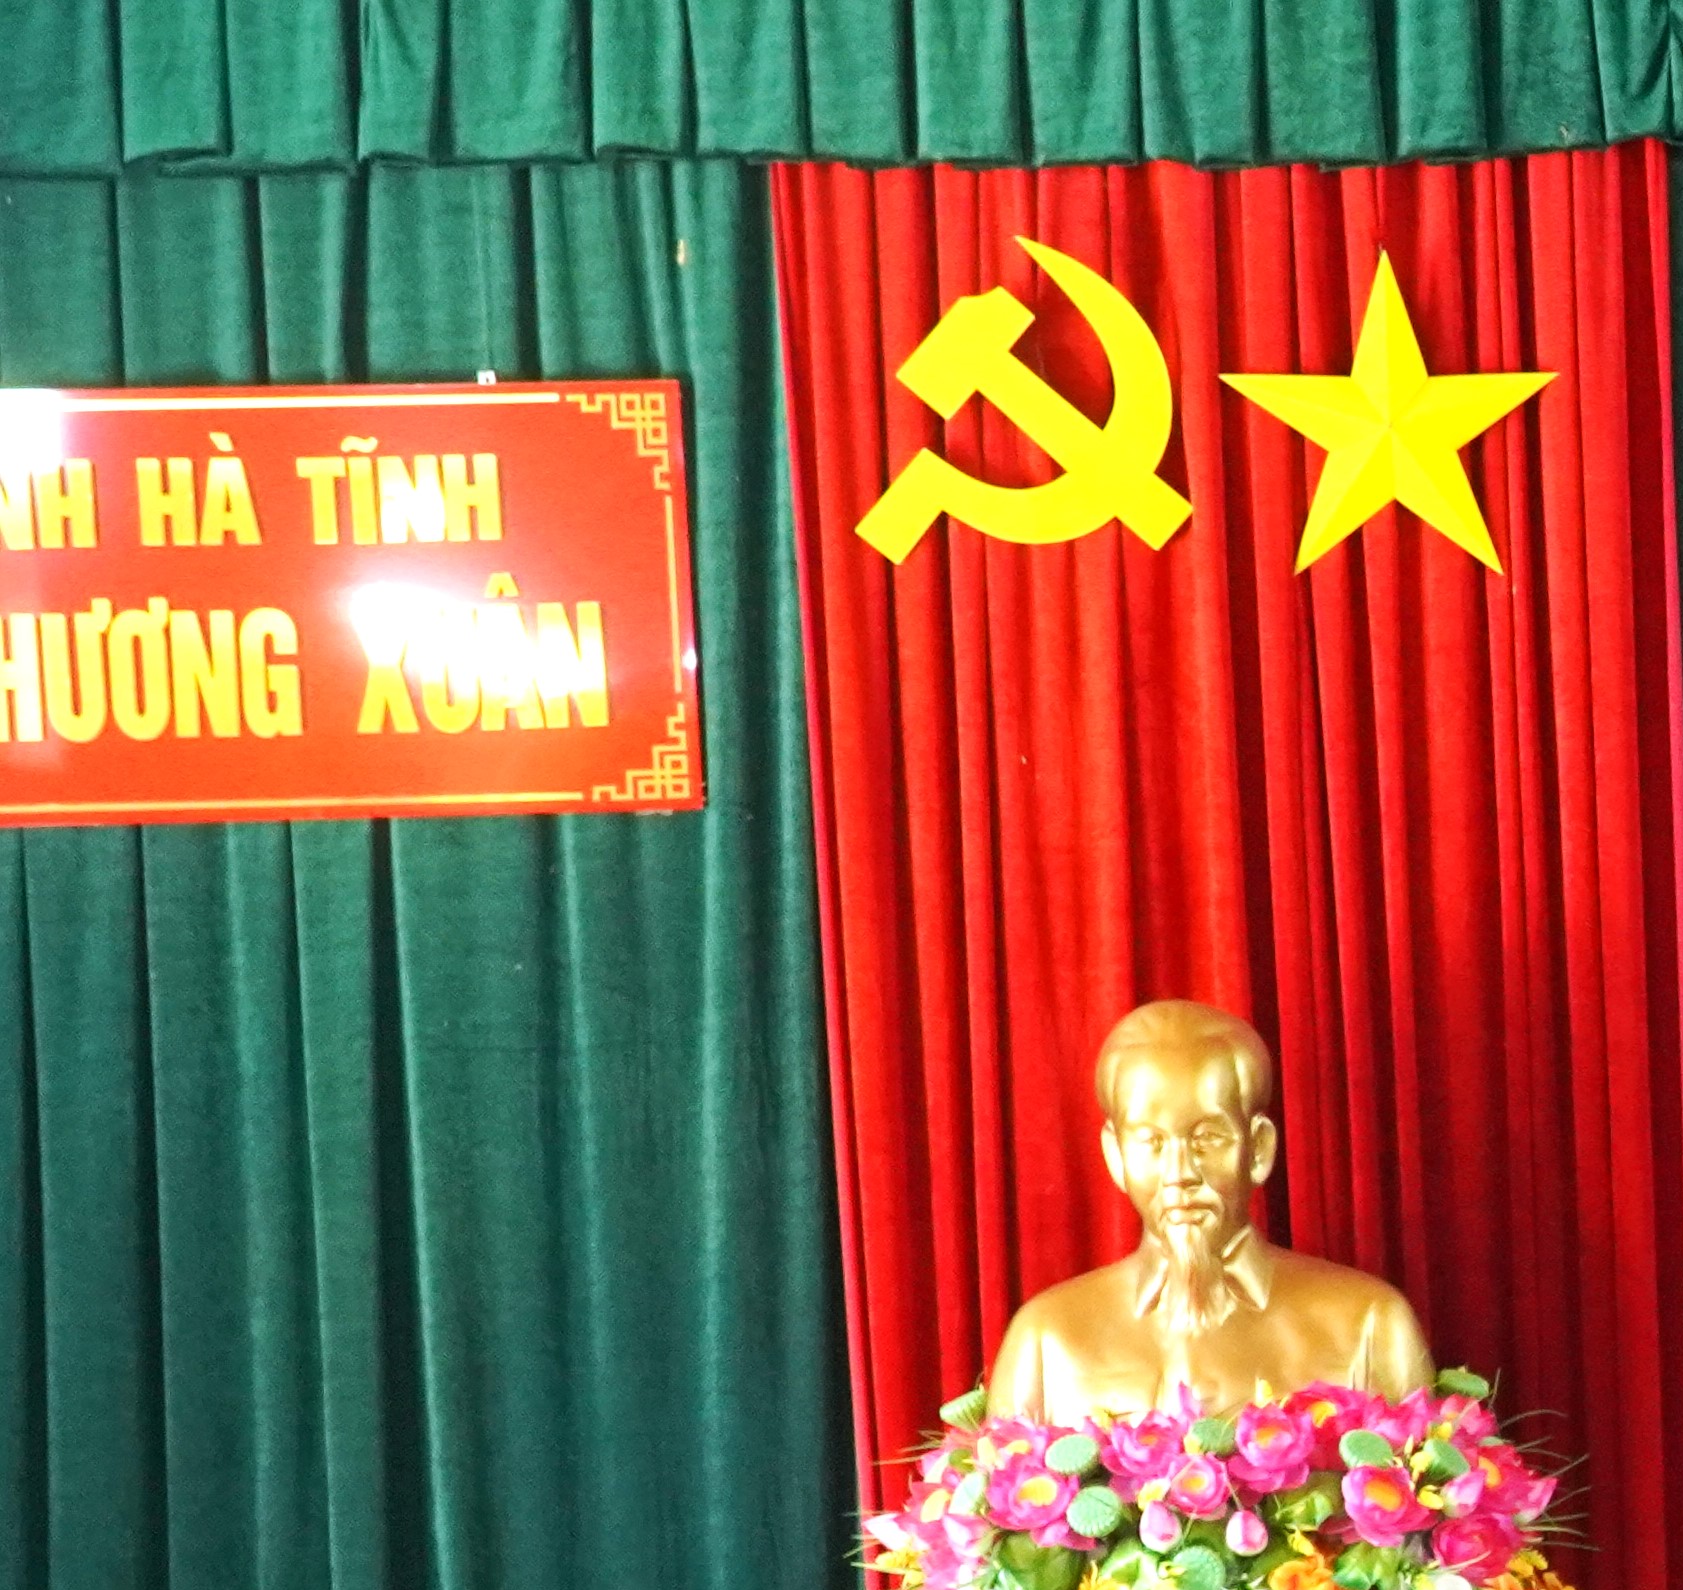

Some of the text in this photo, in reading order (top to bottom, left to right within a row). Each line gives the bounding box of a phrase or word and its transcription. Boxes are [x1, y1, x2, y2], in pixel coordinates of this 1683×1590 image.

[136, 432, 262, 546] HÀ
[296, 435, 502, 545] TĨNH
[348, 572, 609, 734] XUÂN
